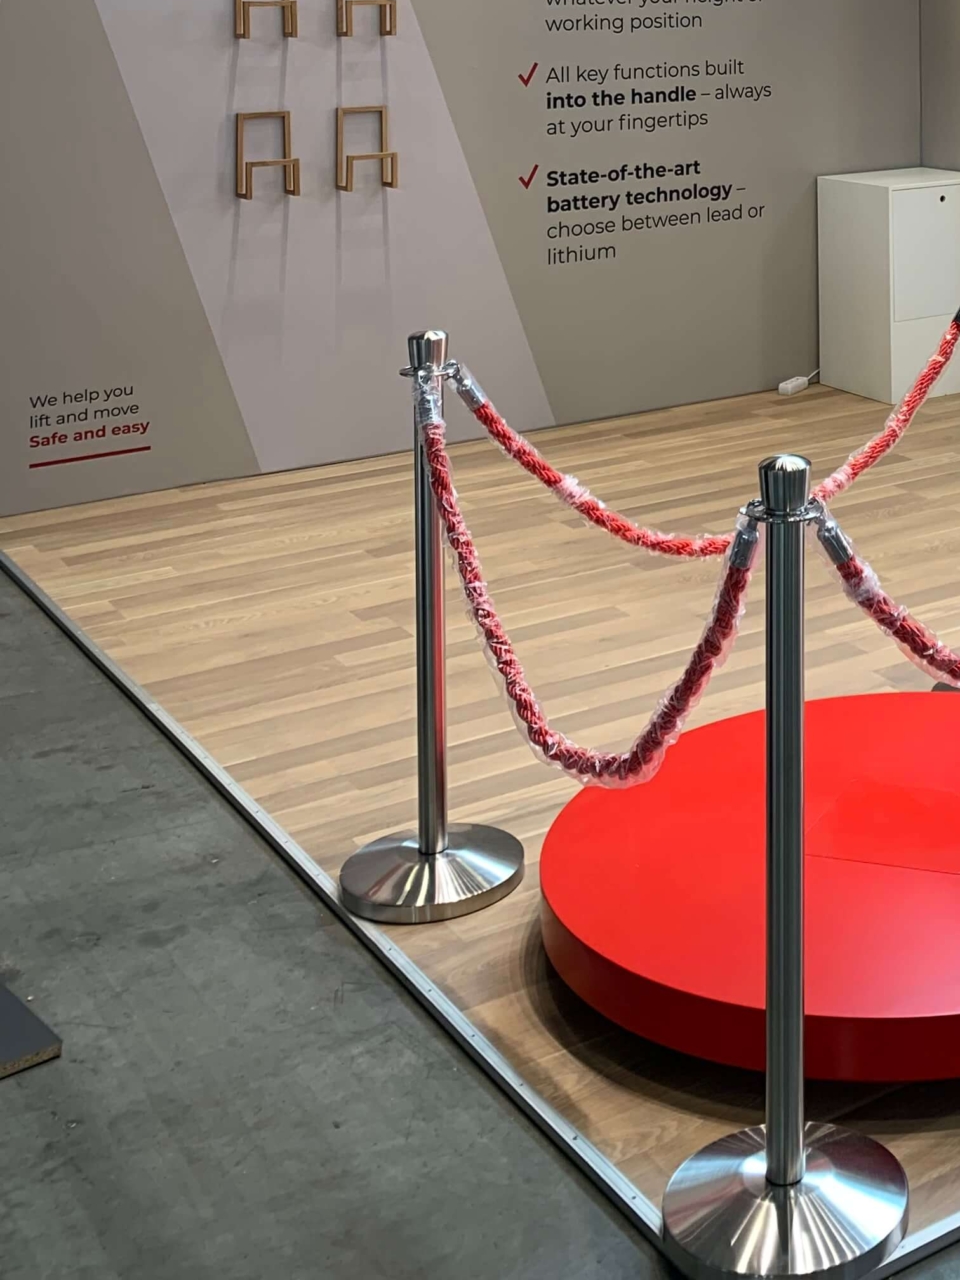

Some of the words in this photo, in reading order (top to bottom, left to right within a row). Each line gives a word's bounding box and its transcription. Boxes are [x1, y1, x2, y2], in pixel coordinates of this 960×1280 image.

[545, 14, 624, 33] working
[630, 12, 702, 33] position
[546, 66, 570, 83] All
[576, 65, 609, 85] key
[613, 62, 700, 81] functions
[705, 59, 745, 76] built
[546, 91, 587, 110] into
[591, 90, 626, 107] the
[631, 85, 697, 105] handle
[714, 83, 772, 101] always
[546, 119, 566, 135] at
[570, 118, 614, 138] your
[618, 110, 709, 133] fingertips
[546, 160, 701, 187] State-of-the-art
[547, 193, 621, 213] battery
[547, 220, 616, 239] choose
[621, 211, 701, 232] between
[706, 203, 743, 223] lead
[747, 204, 765, 218] or
[547, 244, 616, 265] lithium
[29, 395, 58, 409] We
[62, 389, 100, 405] help
[103, 385, 134, 402] you
[29, 415, 52, 429] lift
[56, 408, 88, 425] and
[93, 404, 140, 420] move
[29, 432, 68, 448] Safe
[73, 425, 106, 442] and
[111, 421, 150, 436] easy
